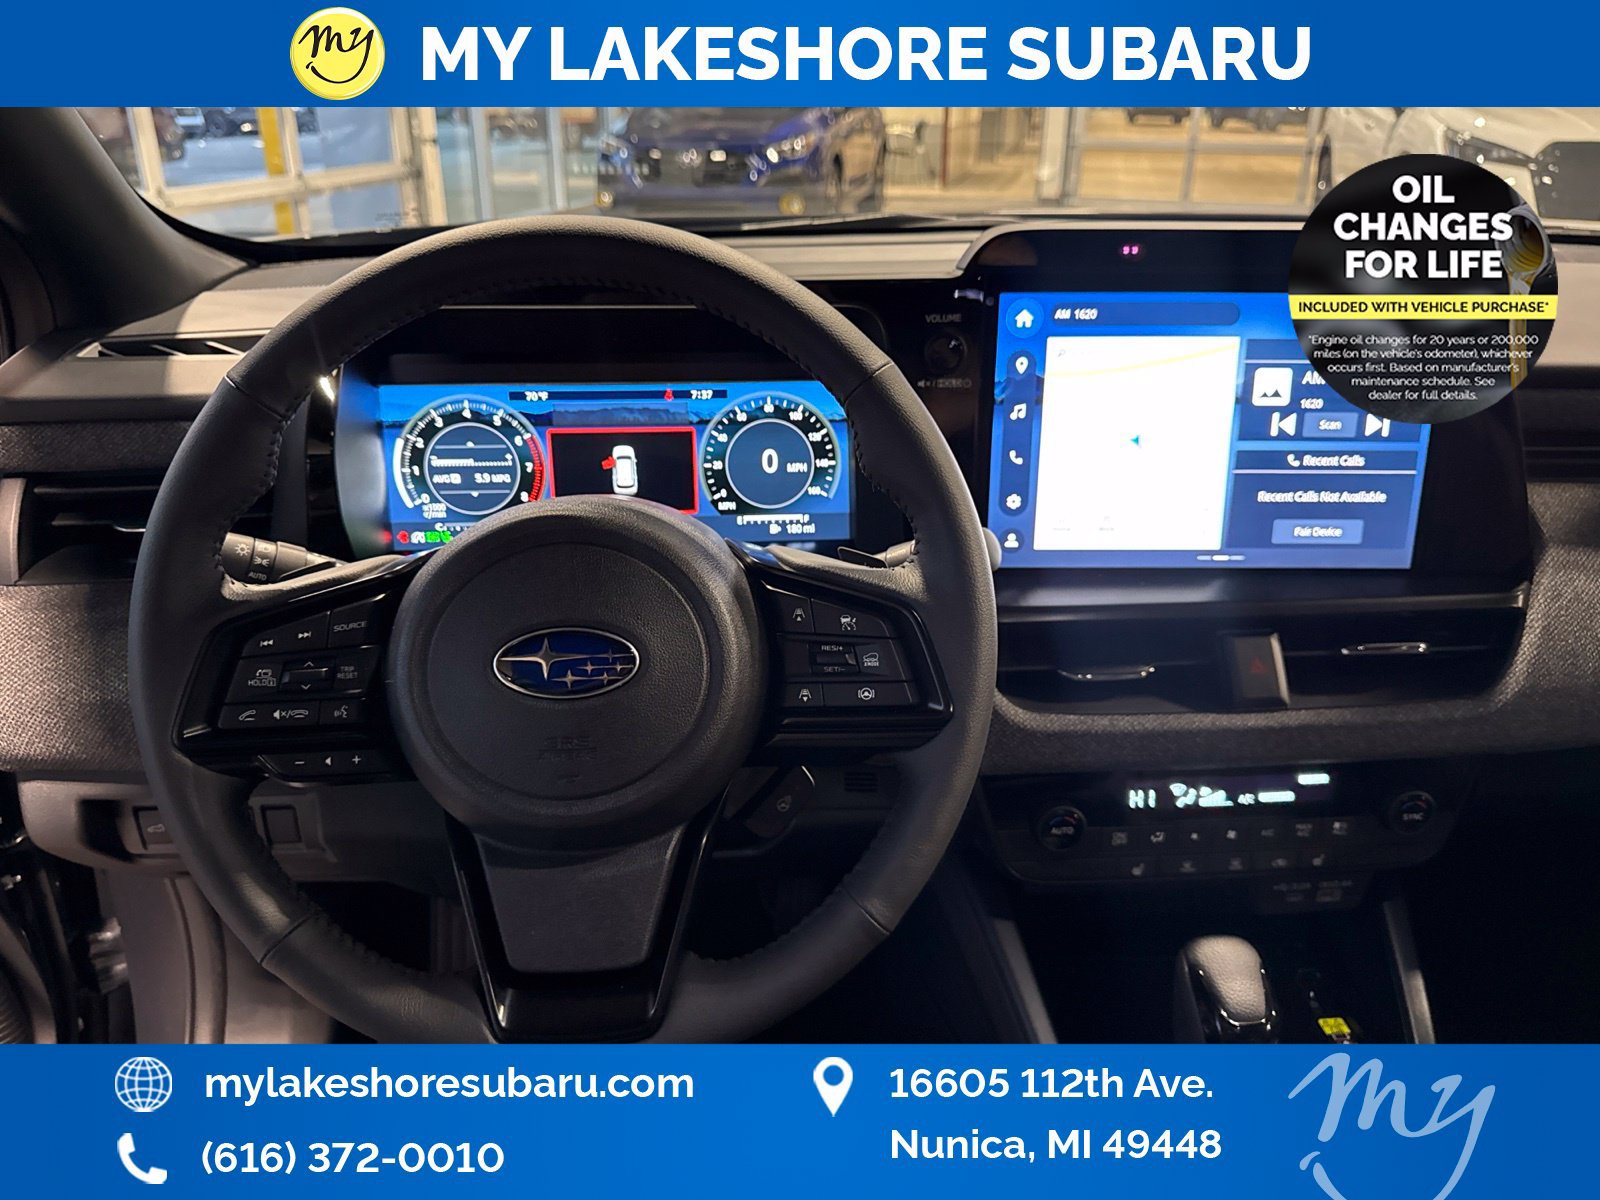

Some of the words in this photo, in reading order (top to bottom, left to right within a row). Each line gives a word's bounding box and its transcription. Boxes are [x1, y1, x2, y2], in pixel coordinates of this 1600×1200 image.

[925, 313, 962, 323] VOLUME
[1054, 308, 1071, 320] AM
[1074, 308, 1098, 320] 1620
[1300, 398, 1324, 409] 1620
[1318, 419, 1343, 430] Scan
[761, 448, 779, 474] 0
[786, 462, 808, 473] MPH
[1302, 454, 1339, 466] Recent
[1339, 454, 1366, 466] Calls
[1257, 490, 1294, 503] Recent
[1294, 490, 1319, 503] Calls
[1319, 490, 1340, 503] Not
[1340, 490, 1387, 503] Available
[718, 501, 737, 511] MPH
[1312, 526, 1343, 537] Device
[247, 571, 267, 581] AUTO
[333, 620, 368, 633] SOURCE
